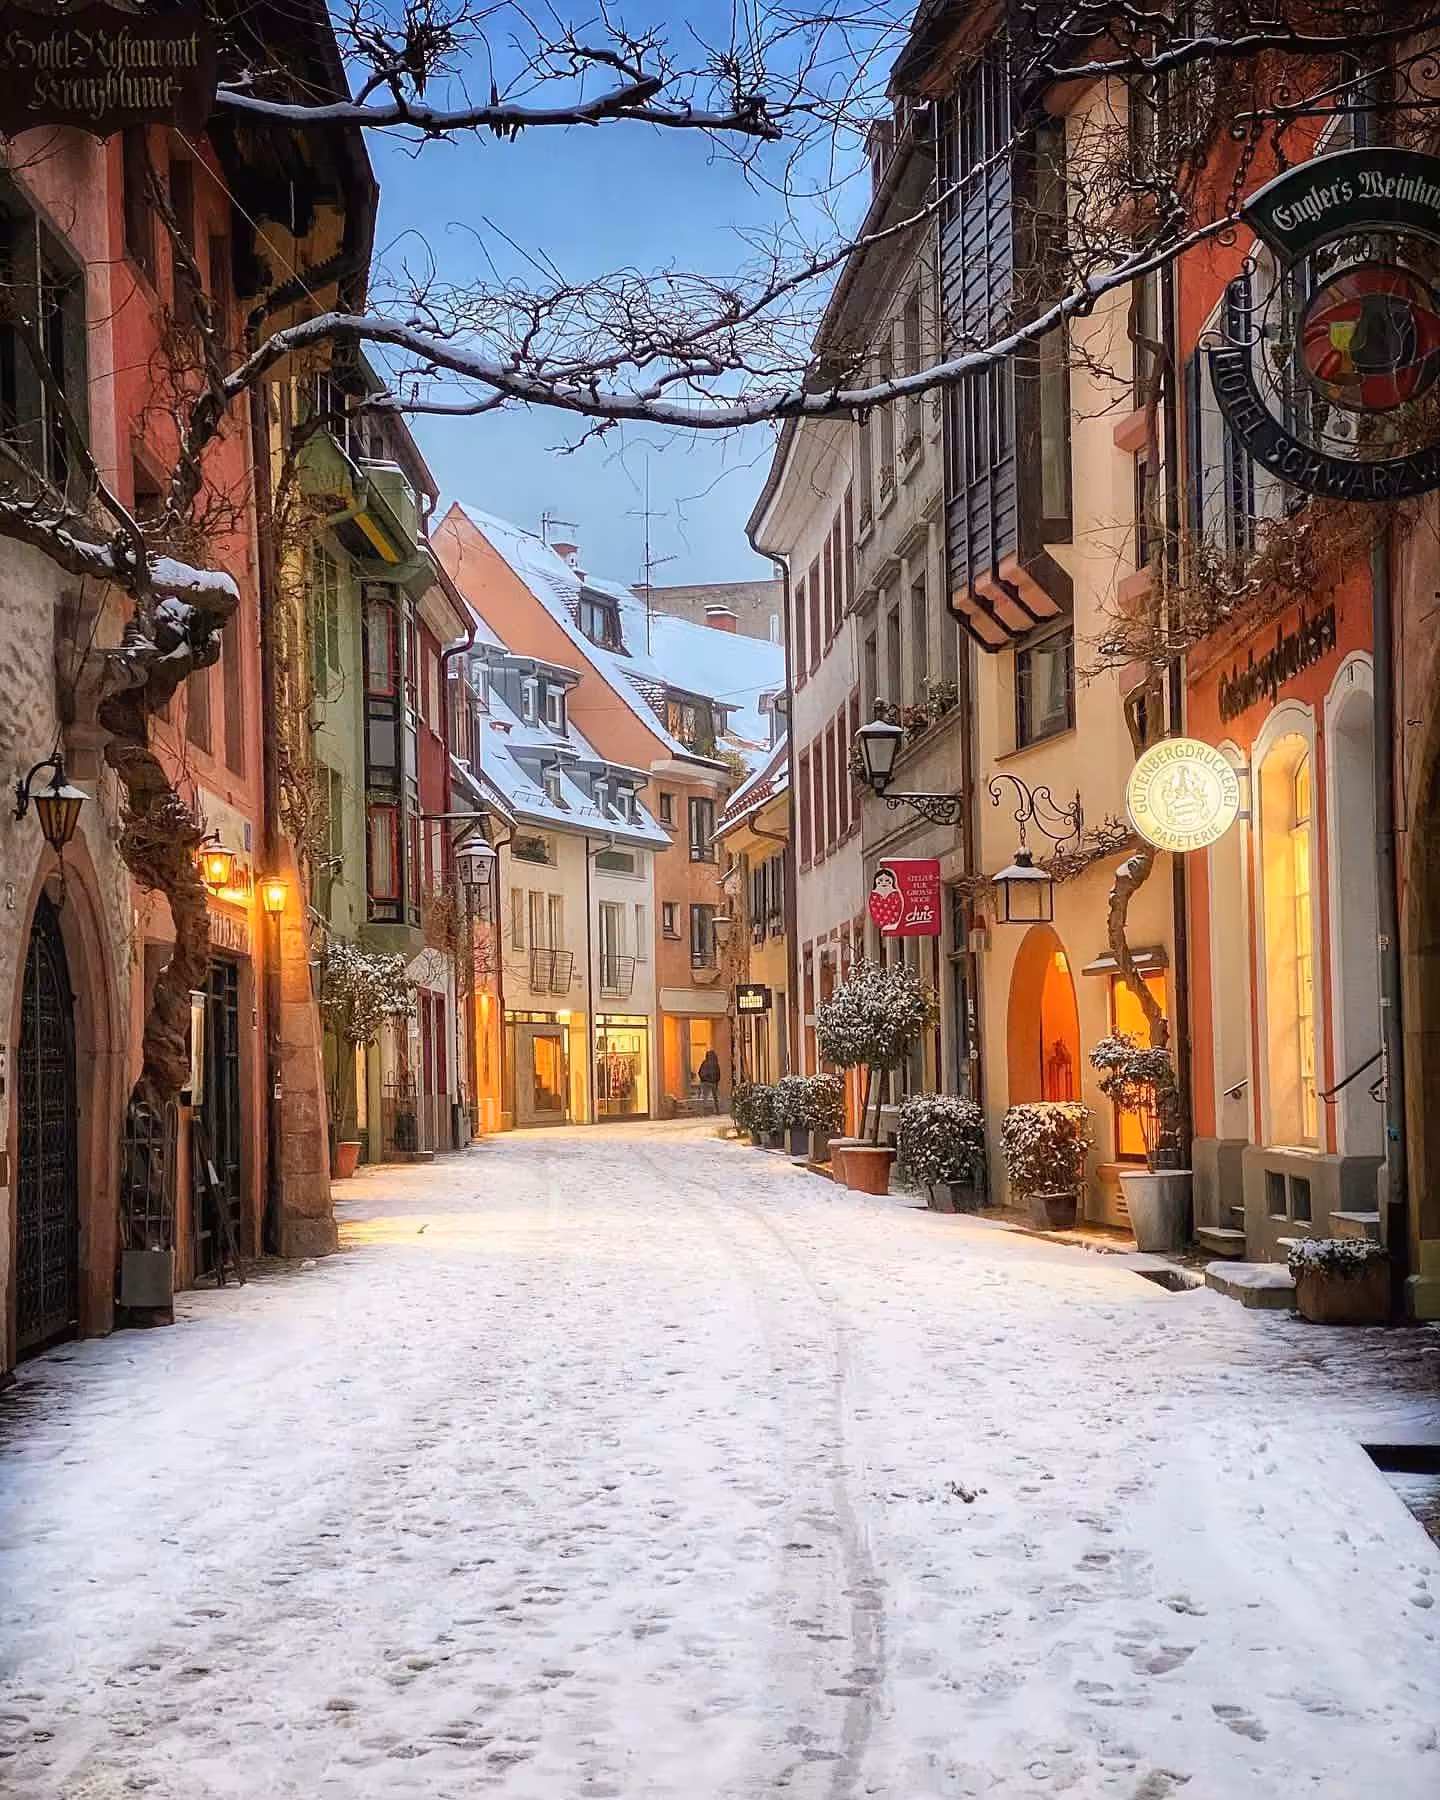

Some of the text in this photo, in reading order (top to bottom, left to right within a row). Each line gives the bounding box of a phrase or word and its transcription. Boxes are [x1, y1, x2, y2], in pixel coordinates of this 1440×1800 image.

[1272, 176, 1353, 231] Engler's
[1215, 352, 1266, 443] HOTEL
[1134, 744, 1237, 814] GUTENBERGDRUCKEREI
[1152, 823, 1222, 848] PAPETERIE
[905, 905, 935, 922] chris
